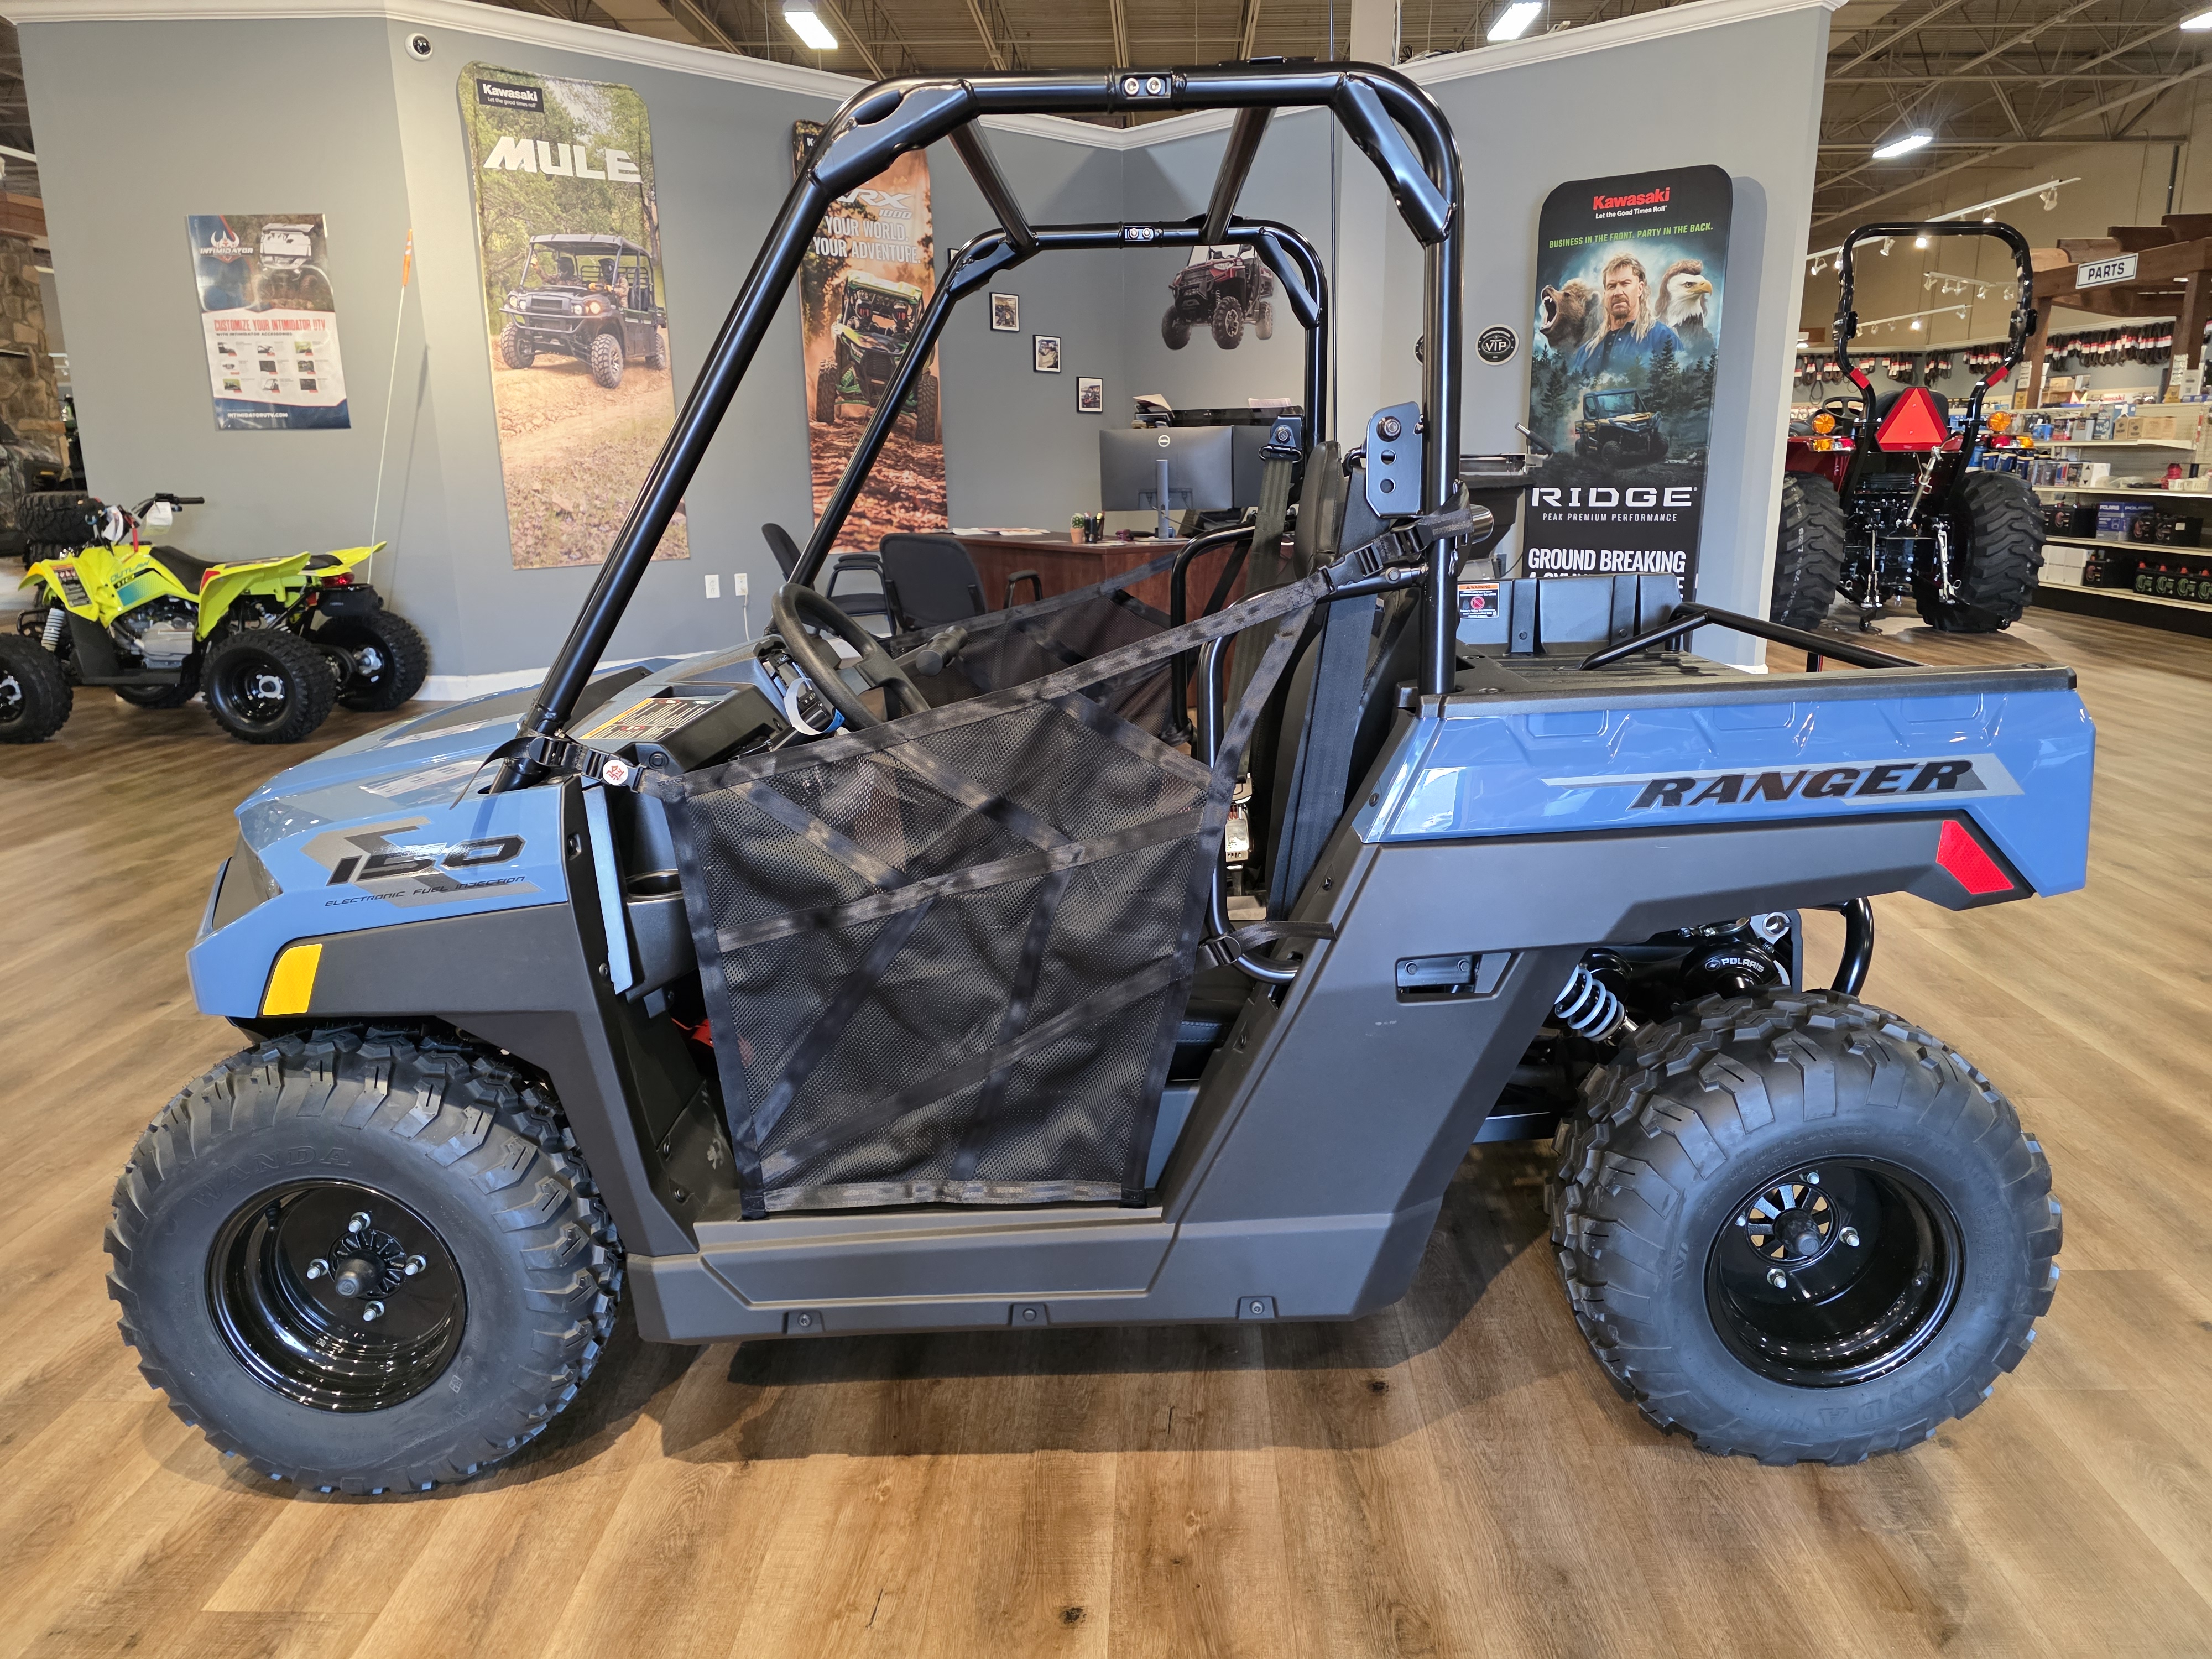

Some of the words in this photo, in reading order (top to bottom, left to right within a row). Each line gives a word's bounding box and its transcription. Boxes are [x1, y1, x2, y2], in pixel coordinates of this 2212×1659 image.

[482, 84, 538, 101] Kawasaki
[483, 136, 643, 183] MULE
[1593, 187, 1670, 210] Kawasaki
[878, 209, 912, 219] 1000
[824, 215, 859, 236] YOUR
[863, 220, 909, 242] WORLD.
[1549, 237, 1583, 248] BUSINESS
[1585, 235, 1592, 243] IN
[1594, 233, 1608, 243] THE
[1609, 231, 1635, 241] FRONT.
[1637, 228, 1662, 238] PARTY
[1663, 226, 1671, 235] IN
[1673, 225, 1688, 233] THE
[1689, 222, 1713, 232] BACK.
[812, 236, 848, 257] YOUR
[851, 241, 921, 264] ADVENTURE.
[2088, 262, 2125, 281] PARTS
[214, 319, 251, 331] CUSTOMIZE
[252, 319, 270, 331] YOUR
[271, 319, 311, 331] INTIMIDATOR
[312, 319, 326, 331] UTV
[1485, 341, 1506, 351] VIP
[1531, 487, 1693, 507] RIDGE
[1542, 513, 1563, 521] PEAK
[1611, 513, 1677, 521] PERFORMANCE
[110, 560, 150, 582] OUTLAW
[1528, 548, 1597, 571] GROUND
[1599, 550, 1686, 573] BREAKING
[1629, 759, 1973, 810] RANGER
[326, 834, 527, 886] 150
[325, 890, 406, 906] ELECTRONIC
[413, 886, 448, 895] FUEL
[455, 876, 525, 889] INJECTION
[1721, 958, 1765, 973] POLARIS
[190, 1145, 352, 1208] WANDA
[1818, 1342, 1976, 1428] WANDA
